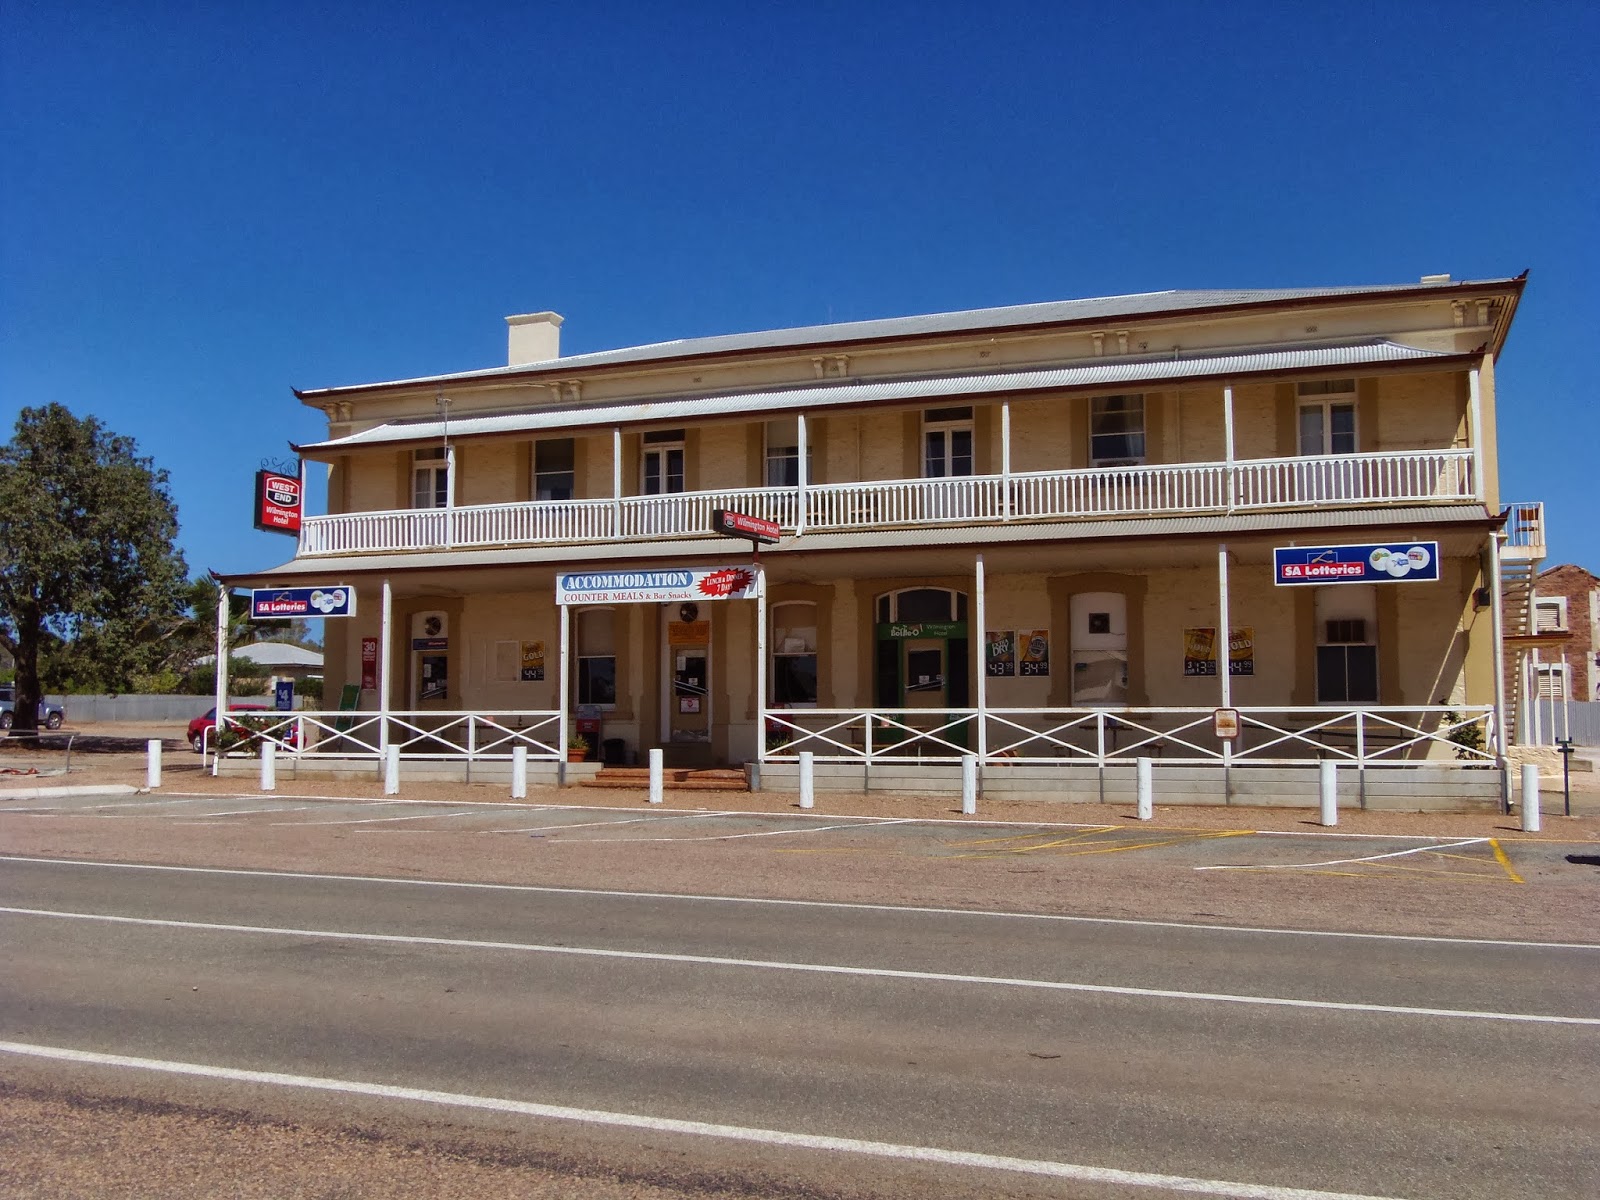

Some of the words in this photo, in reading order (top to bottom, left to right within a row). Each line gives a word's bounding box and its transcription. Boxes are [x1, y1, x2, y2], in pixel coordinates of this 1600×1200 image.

[271, 481, 295, 492] WEST
[274, 492, 292, 503] END
[266, 506, 298, 518] Wilmington
[273, 516, 289, 525] Hotel
[737, 516, 766, 532] Wilmington
[766, 524, 779, 535] Hotel
[1285, 566, 1302, 576] SA
[1305, 564, 1362, 575] Lotteries
[566, 572, 688, 590] ACCOMMODATION
[706, 576, 722, 586] LUNCH
[564, 592, 609, 602] COUNTER
[612, 591, 644, 601] MEALS
[668, 591, 692, 599] Snacks
[259, 603, 270, 611] SA
[271, 602, 306, 611] Lotteries
[1229, 639, 1252, 650] OLD
[523, 650, 544, 661] GOLD
[992, 644, 1009, 657] DRY
